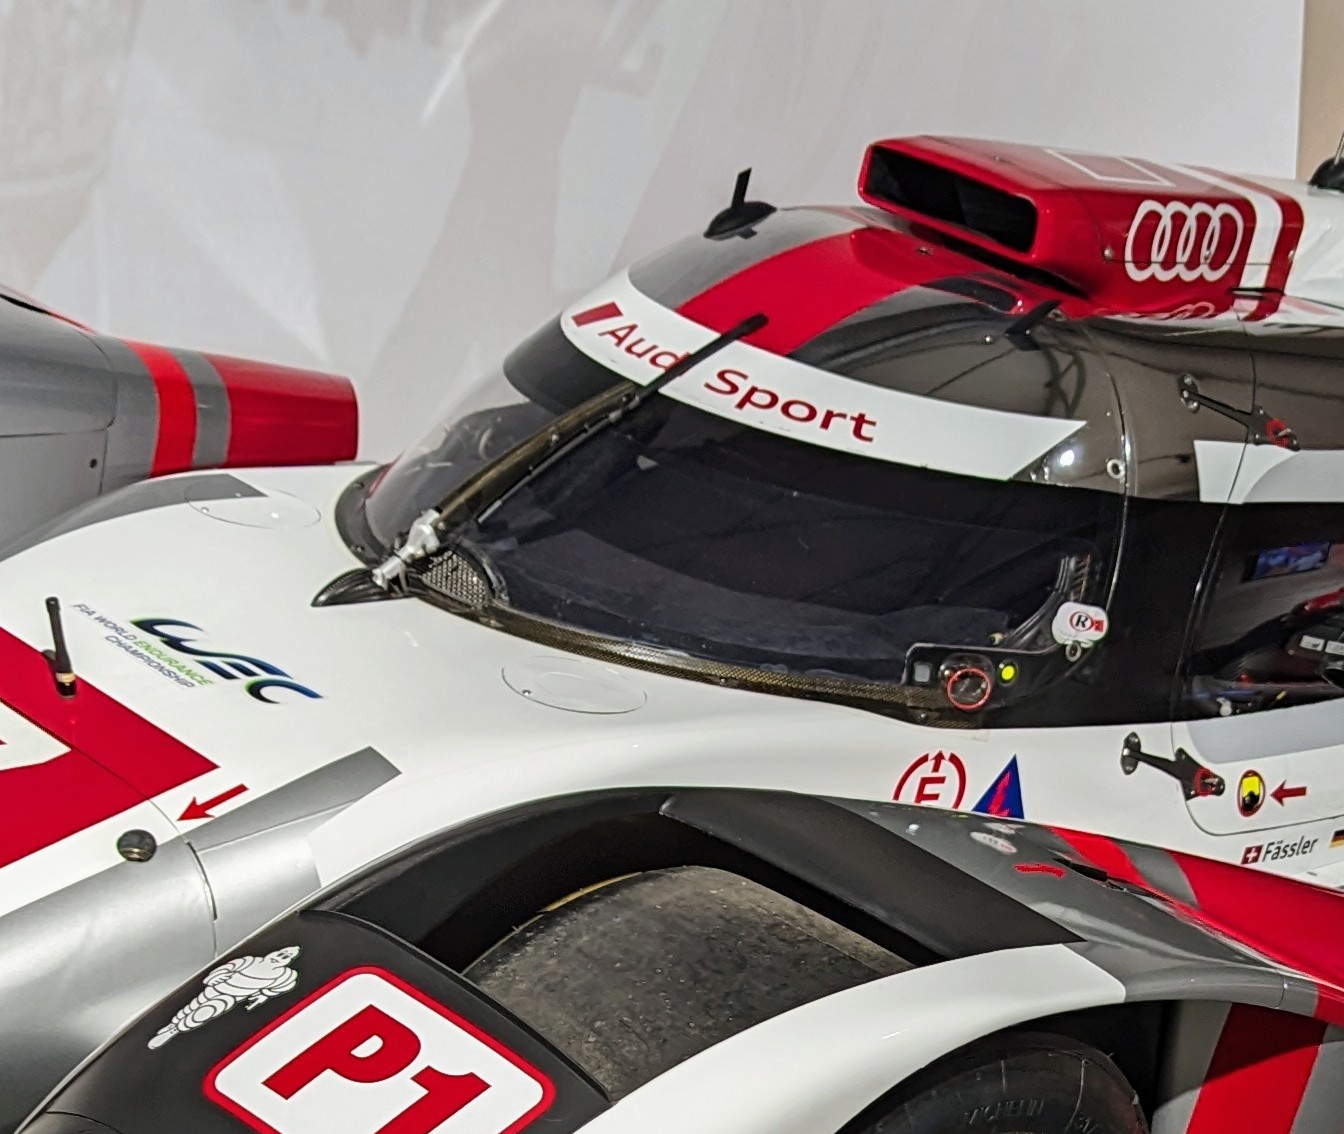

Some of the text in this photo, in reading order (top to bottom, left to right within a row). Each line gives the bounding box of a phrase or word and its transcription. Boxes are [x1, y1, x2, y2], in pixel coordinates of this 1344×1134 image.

[598, 323, 877, 443] Aud Sport
[105, 635, 196, 689] CHAMPIONSHIP
[133, 639, 213, 686] ENDURANCE
[1262, 836, 1318, 862] Fässler
